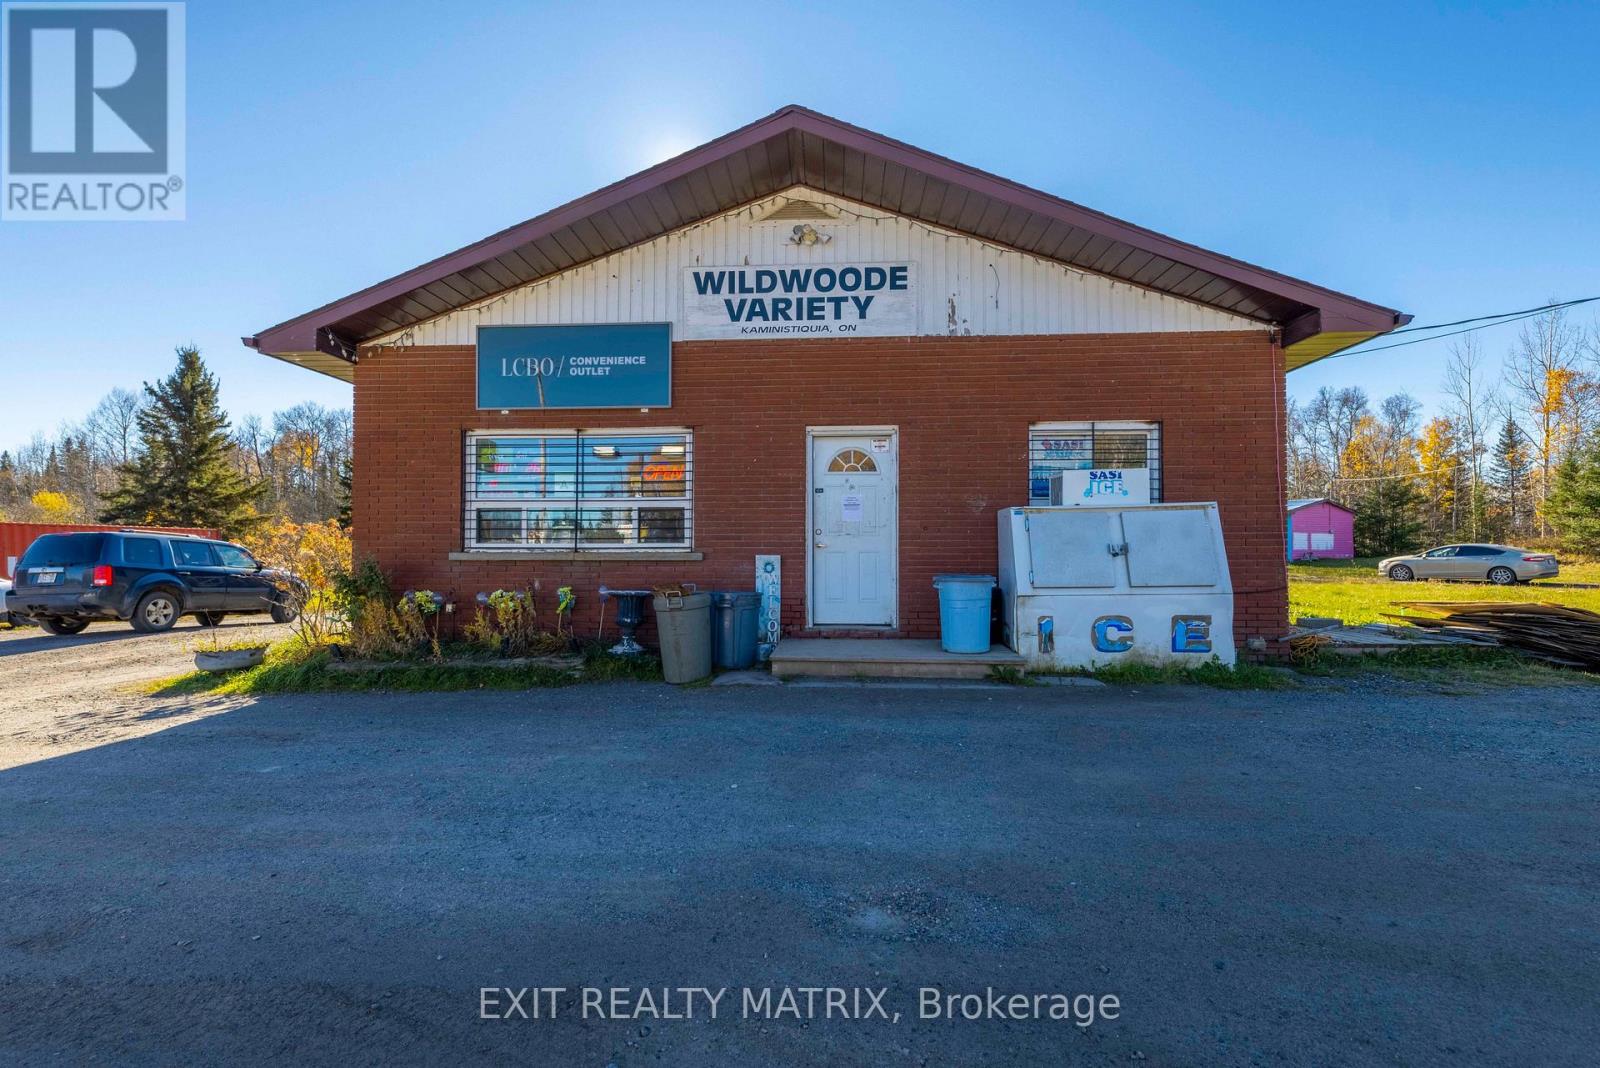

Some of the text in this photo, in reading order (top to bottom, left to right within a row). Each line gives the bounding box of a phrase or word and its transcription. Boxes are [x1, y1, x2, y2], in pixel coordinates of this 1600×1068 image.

[693, 266, 908, 295] WILDWOODE
[724, 296, 875, 322] VARIETY
[741, 324, 857, 334] KAMINISTIQUIA, ON
[569, 356, 646, 366] CONVENIENCE
[569, 367, 611, 376] OUTLET
[642, 464, 686, 481] OPEN
[1089, 470, 1122, 480] SASI
[1090, 480, 1125, 495] ICE
[1038, 615, 1212, 652] ICE
